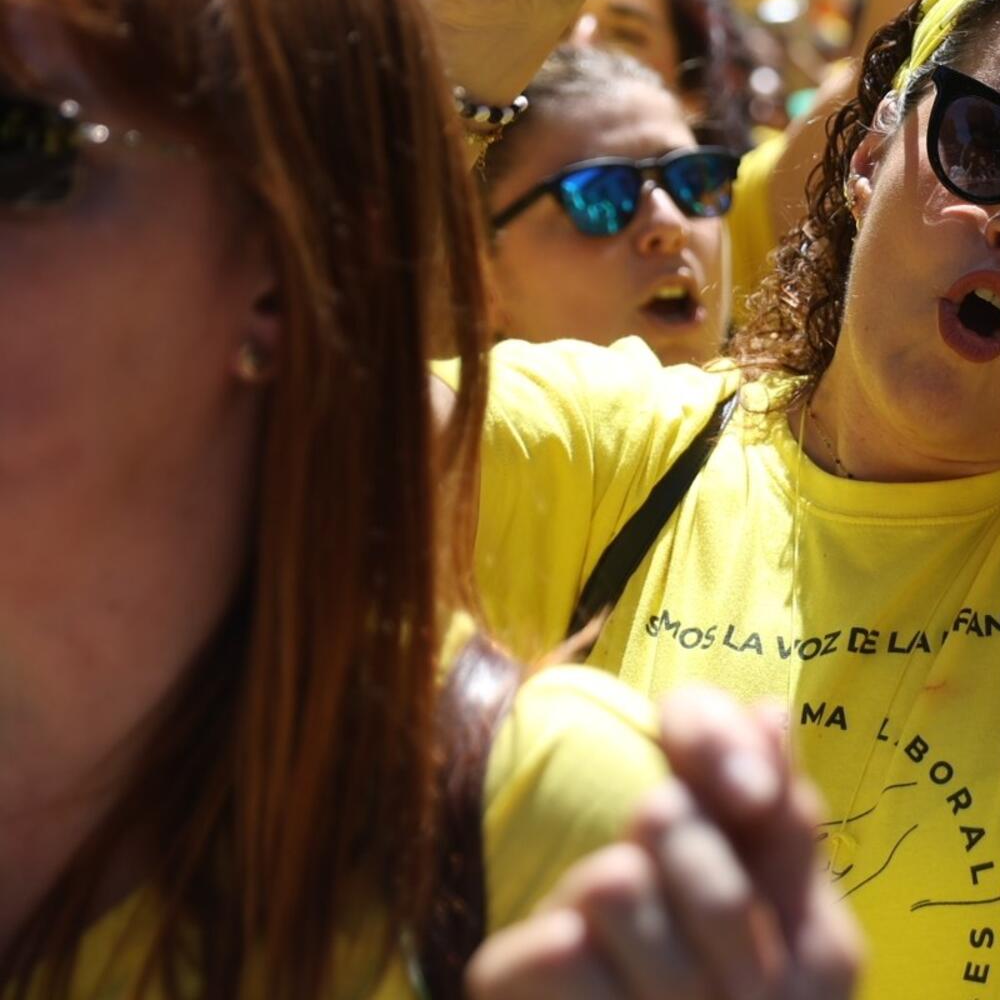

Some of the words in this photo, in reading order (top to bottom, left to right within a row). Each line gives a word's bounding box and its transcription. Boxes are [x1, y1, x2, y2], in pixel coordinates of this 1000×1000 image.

[723, 623, 763, 655] LA
[888, 630, 931, 654] LA
[877, 717, 995, 886] LBORAL
